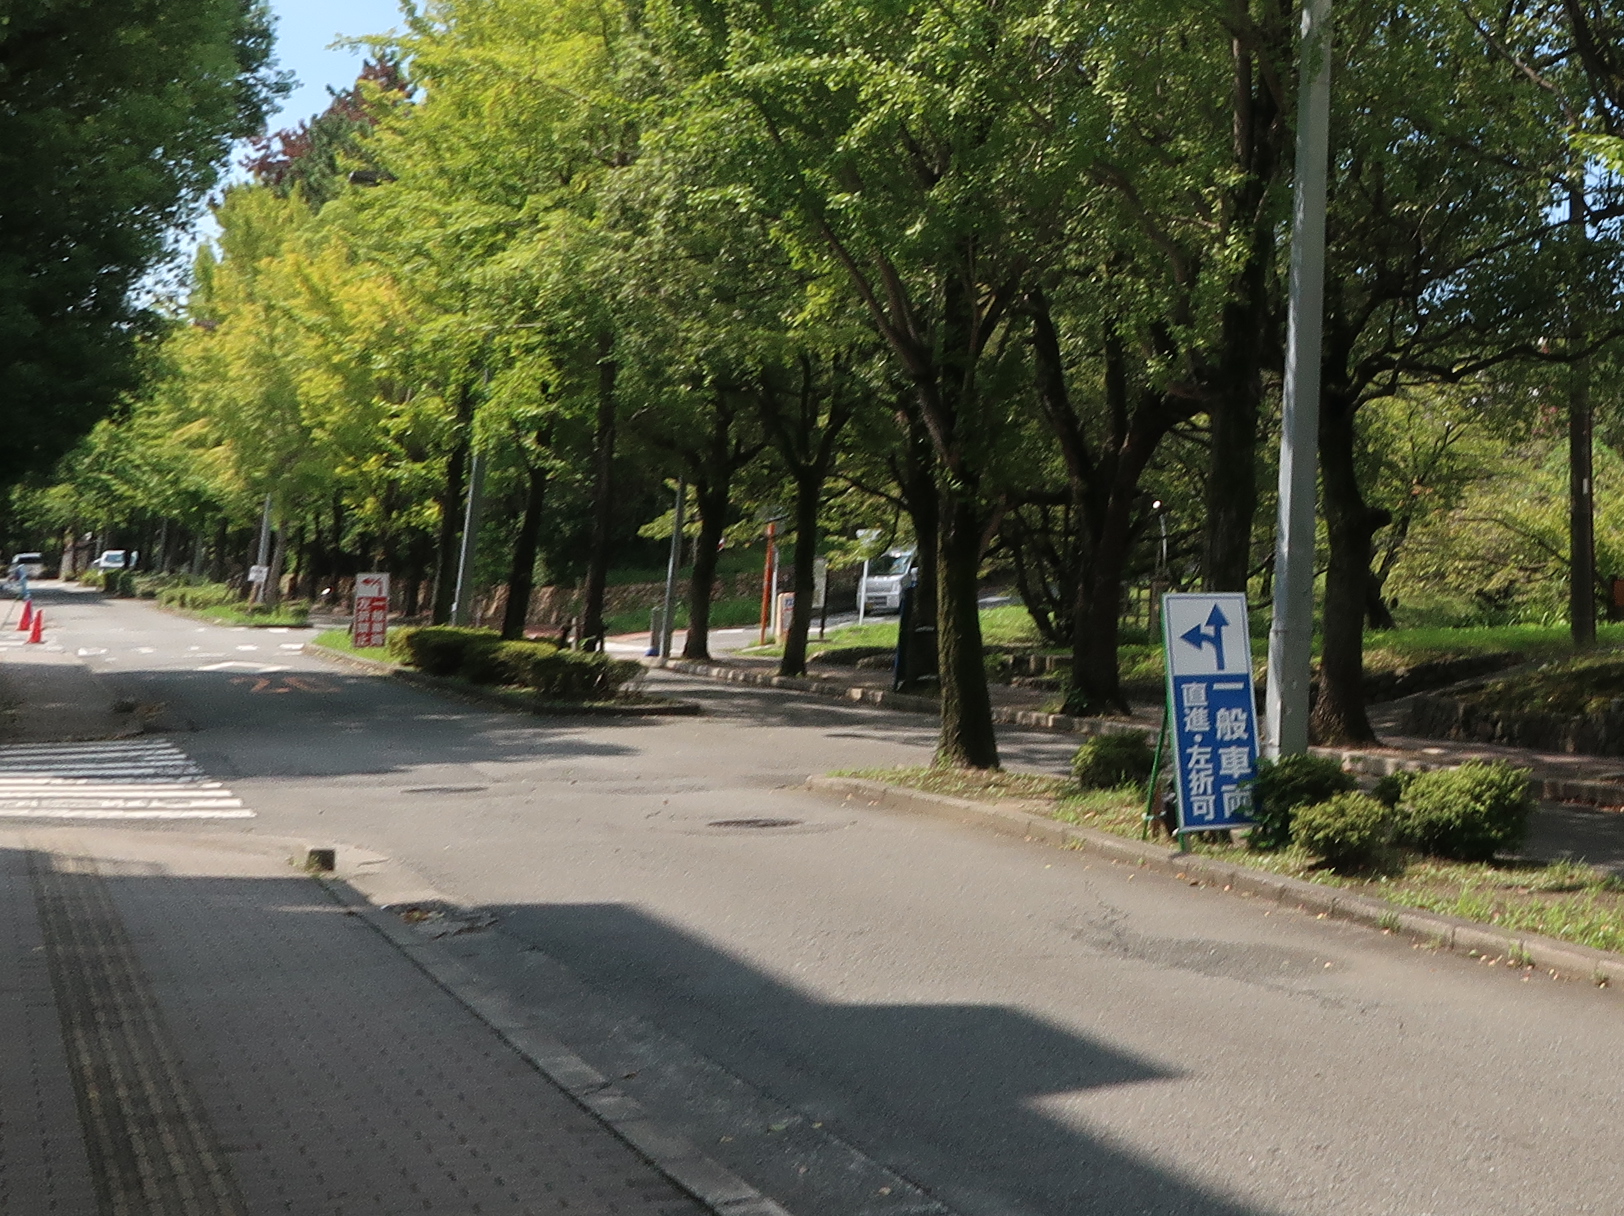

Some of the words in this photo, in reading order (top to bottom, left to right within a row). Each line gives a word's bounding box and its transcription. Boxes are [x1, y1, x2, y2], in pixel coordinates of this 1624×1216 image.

[1180, 682, 1216, 821] 直進・左折可
[1213, 681, 1255, 819] 一般車両
